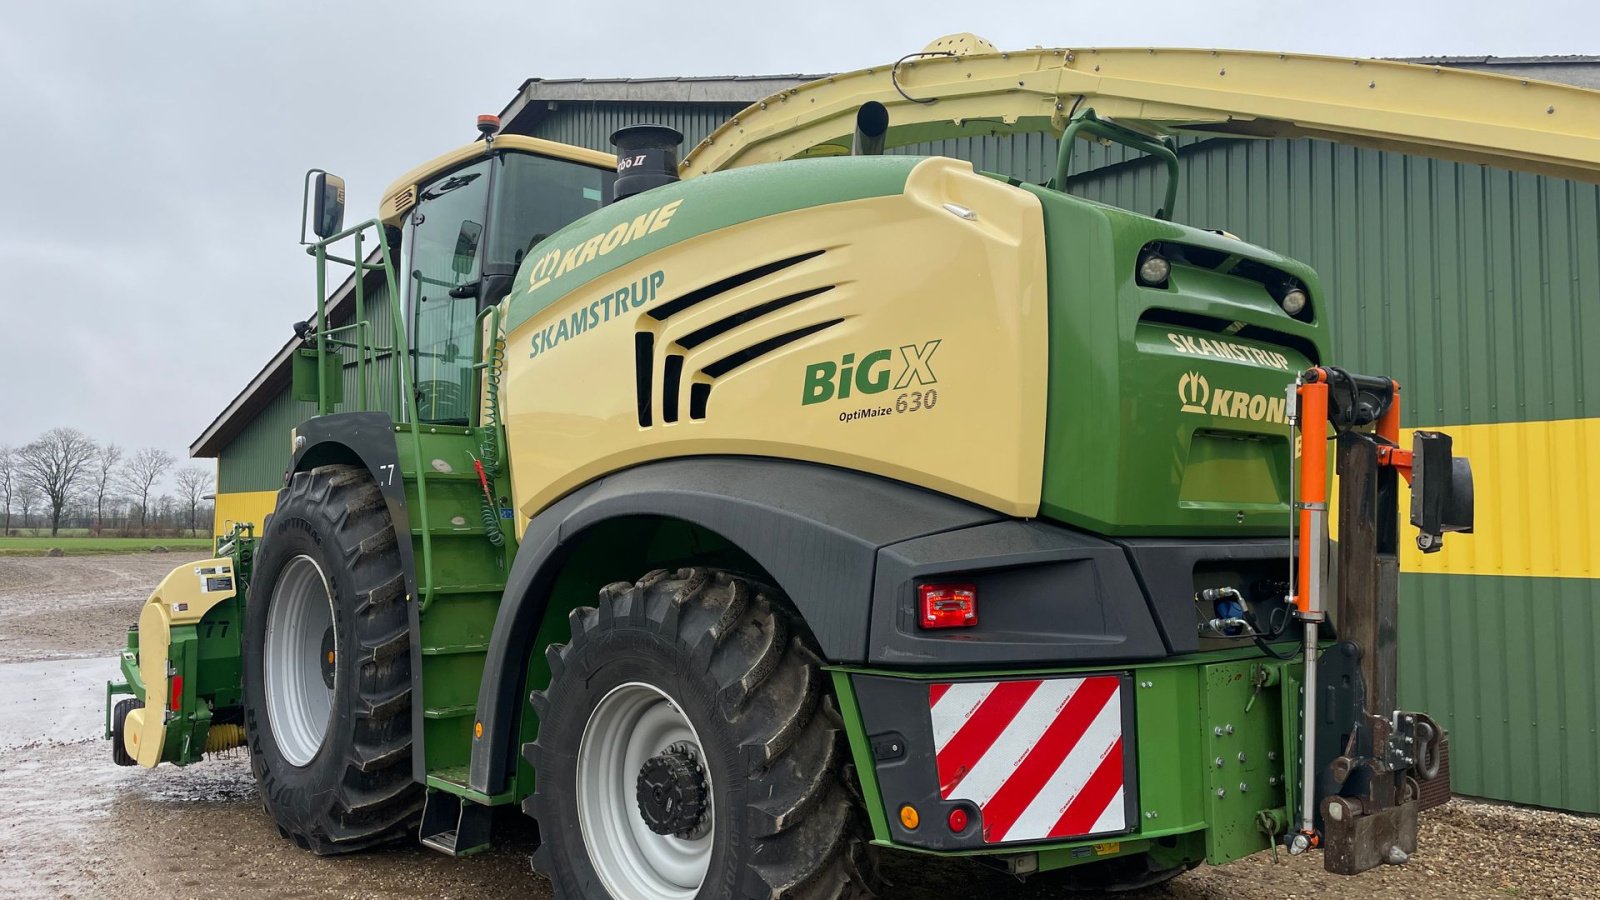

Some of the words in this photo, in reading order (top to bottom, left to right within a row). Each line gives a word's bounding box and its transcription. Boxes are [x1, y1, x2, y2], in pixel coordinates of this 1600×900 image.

[555, 198, 685, 279] KRONE
[529, 270, 665, 359] SKAMSTRUP
[1167, 333, 1289, 370] SKAMSTRUP
[839, 406, 893, 423] OptiMaize
[895, 388, 938, 414] 630
[1210, 388, 1290, 425] KRON
